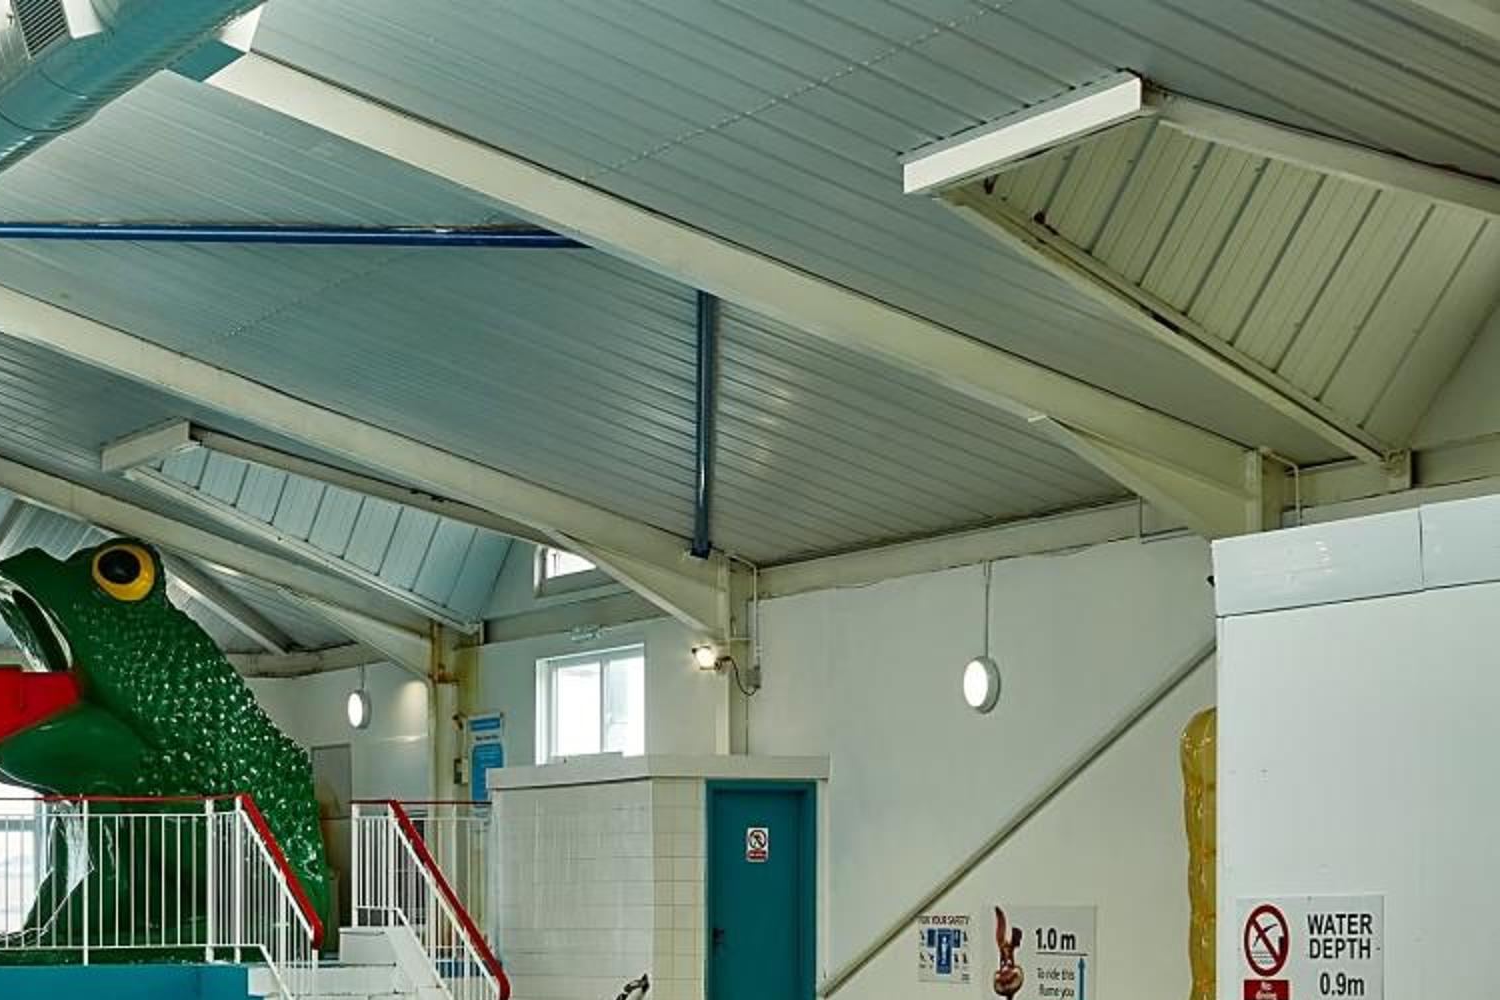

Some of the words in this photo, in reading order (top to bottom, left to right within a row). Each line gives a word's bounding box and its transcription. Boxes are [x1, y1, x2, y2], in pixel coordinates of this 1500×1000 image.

[1307, 913, 1373, 935] WATER
[1035, 927, 1058, 951] 1.0
[1060, 932, 1077, 951] m
[1309, 938, 1371, 959] DEPTH
[1045, 967, 1060, 980] ride
[1061, 968, 1075, 981] this
[1319, 972, 1365, 996] 0.9m
[1060, 987, 1075, 1000] you
